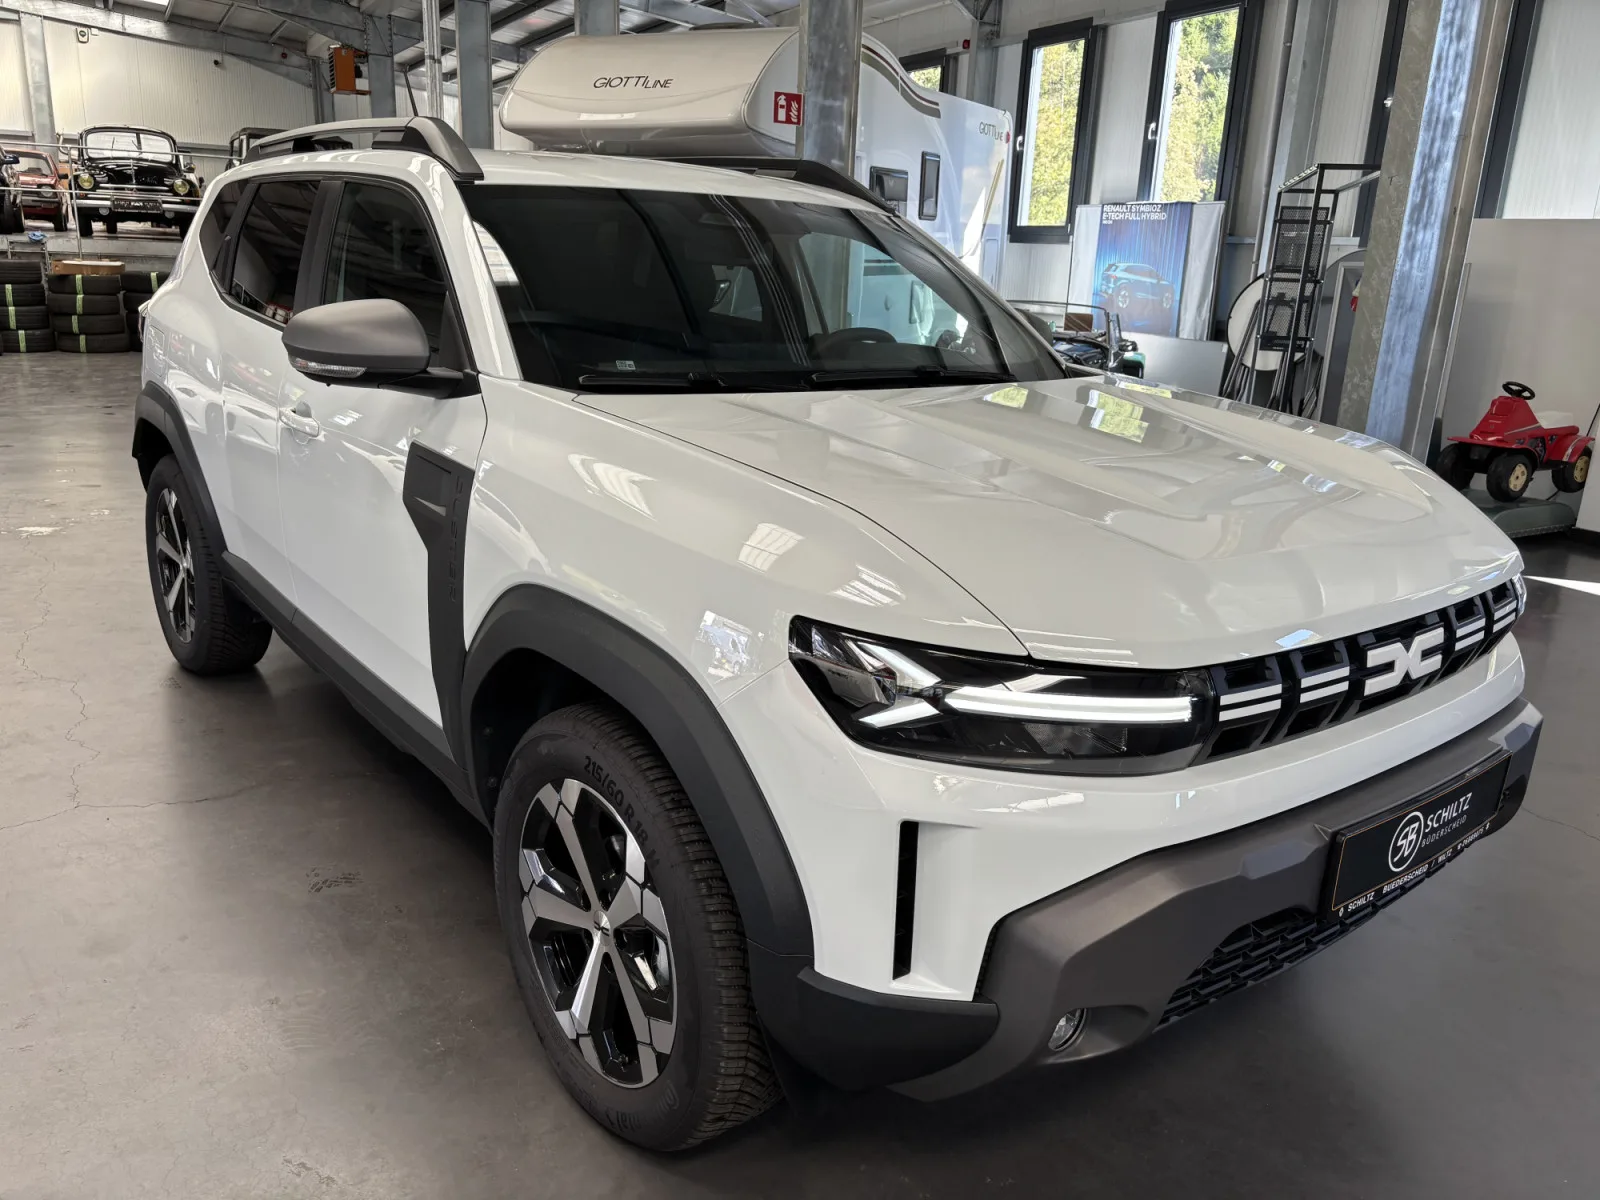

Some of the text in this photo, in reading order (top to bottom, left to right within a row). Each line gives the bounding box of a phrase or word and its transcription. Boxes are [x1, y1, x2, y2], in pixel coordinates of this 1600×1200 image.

[1102, 212, 1167, 220] E-TECH FULL HYBRID
[1103, 204, 1162, 212] RENAULT SYMBIOZ
[583, 755, 625, 807] 215/60
[624, 803, 635, 823] R
[1424, 791, 1473, 833] SCHILTZ
[1347, 892, 1375, 912] SCHILTZ
[1382, 863, 1429, 894] BUEDERSCHEID
